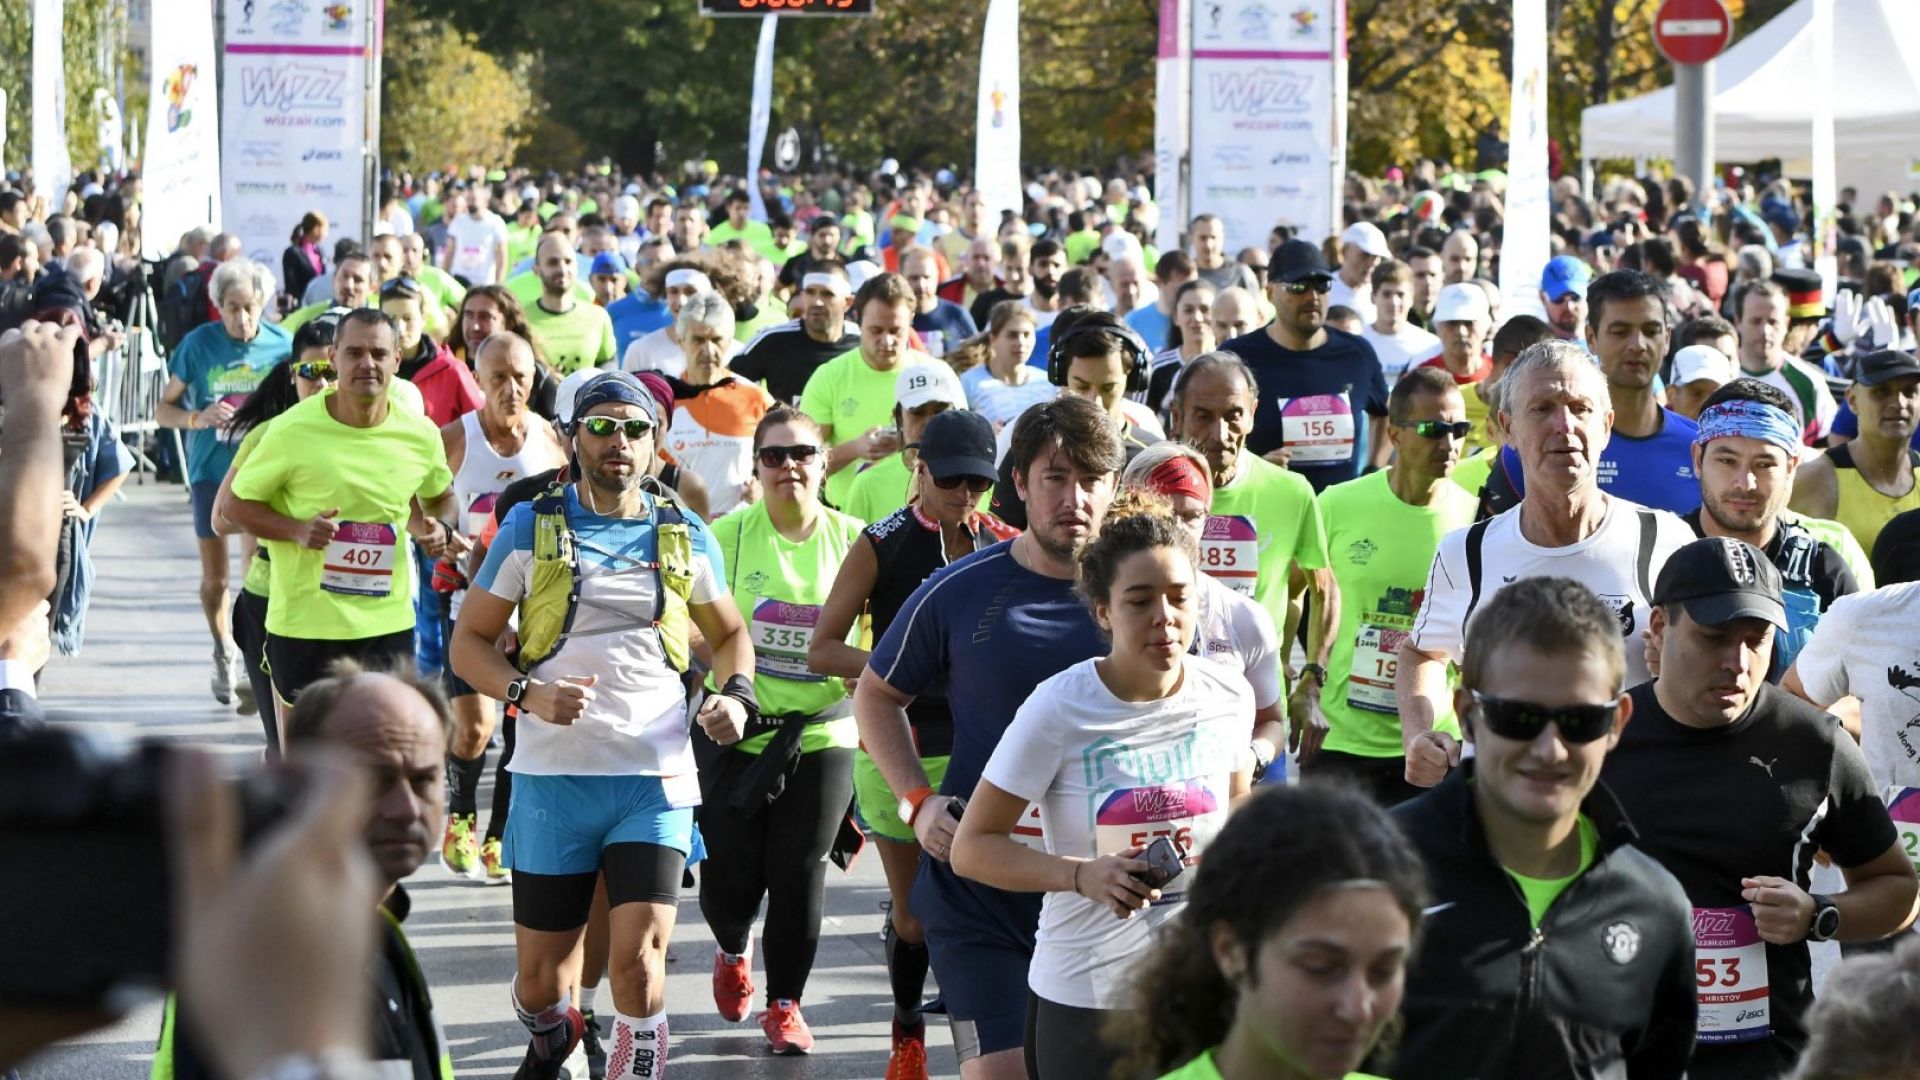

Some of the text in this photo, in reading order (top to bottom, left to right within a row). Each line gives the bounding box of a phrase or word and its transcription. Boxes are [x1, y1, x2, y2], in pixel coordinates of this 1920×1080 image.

[1303, 421, 1334, 436] 156
[875, 512, 907, 540] SPORT
[342, 548, 382, 567] 407
[761, 626, 810, 649] 335
[1696, 938, 1736, 947] izzair.com
[1704, 994, 1741, 1003] HRISTOV
